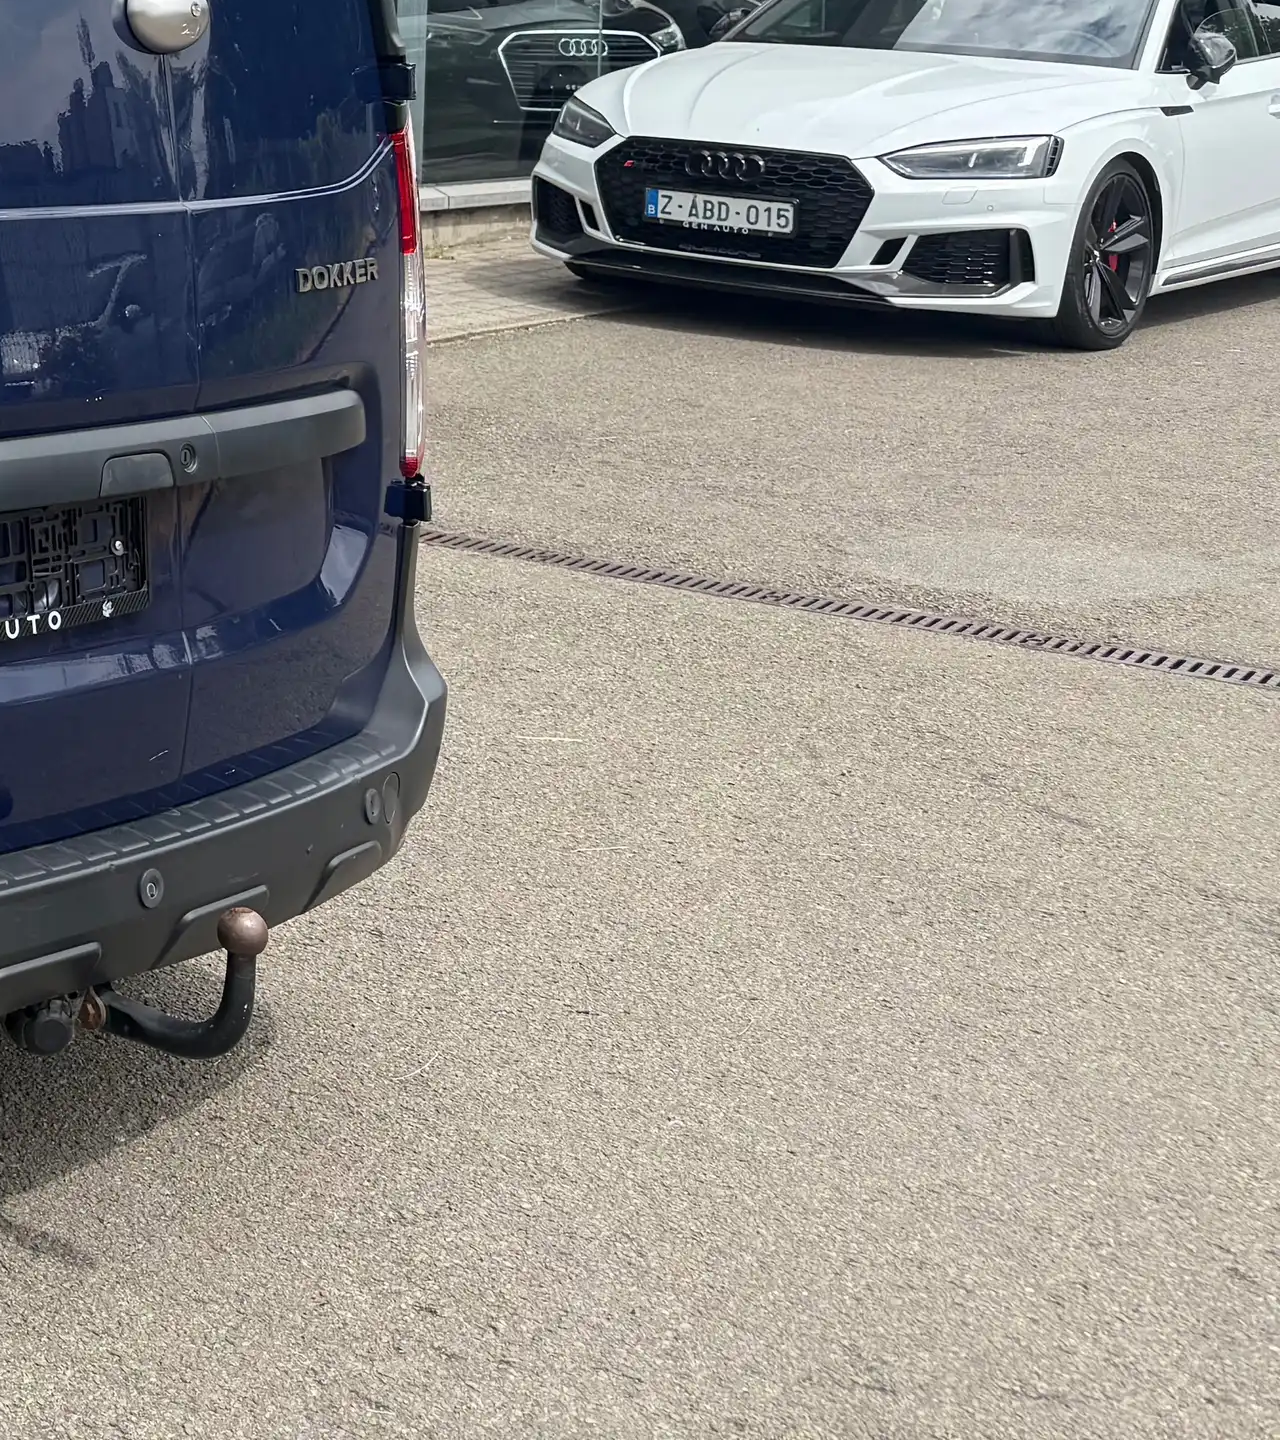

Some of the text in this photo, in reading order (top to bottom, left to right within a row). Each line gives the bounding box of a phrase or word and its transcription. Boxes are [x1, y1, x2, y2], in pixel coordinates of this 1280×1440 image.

[648, 204, 656, 214] B
[660, 194, 790, 229] Z-ABD-015
[683, 221, 749, 235] GEN AUTO
[295, 257, 379, 293] DOKKER
